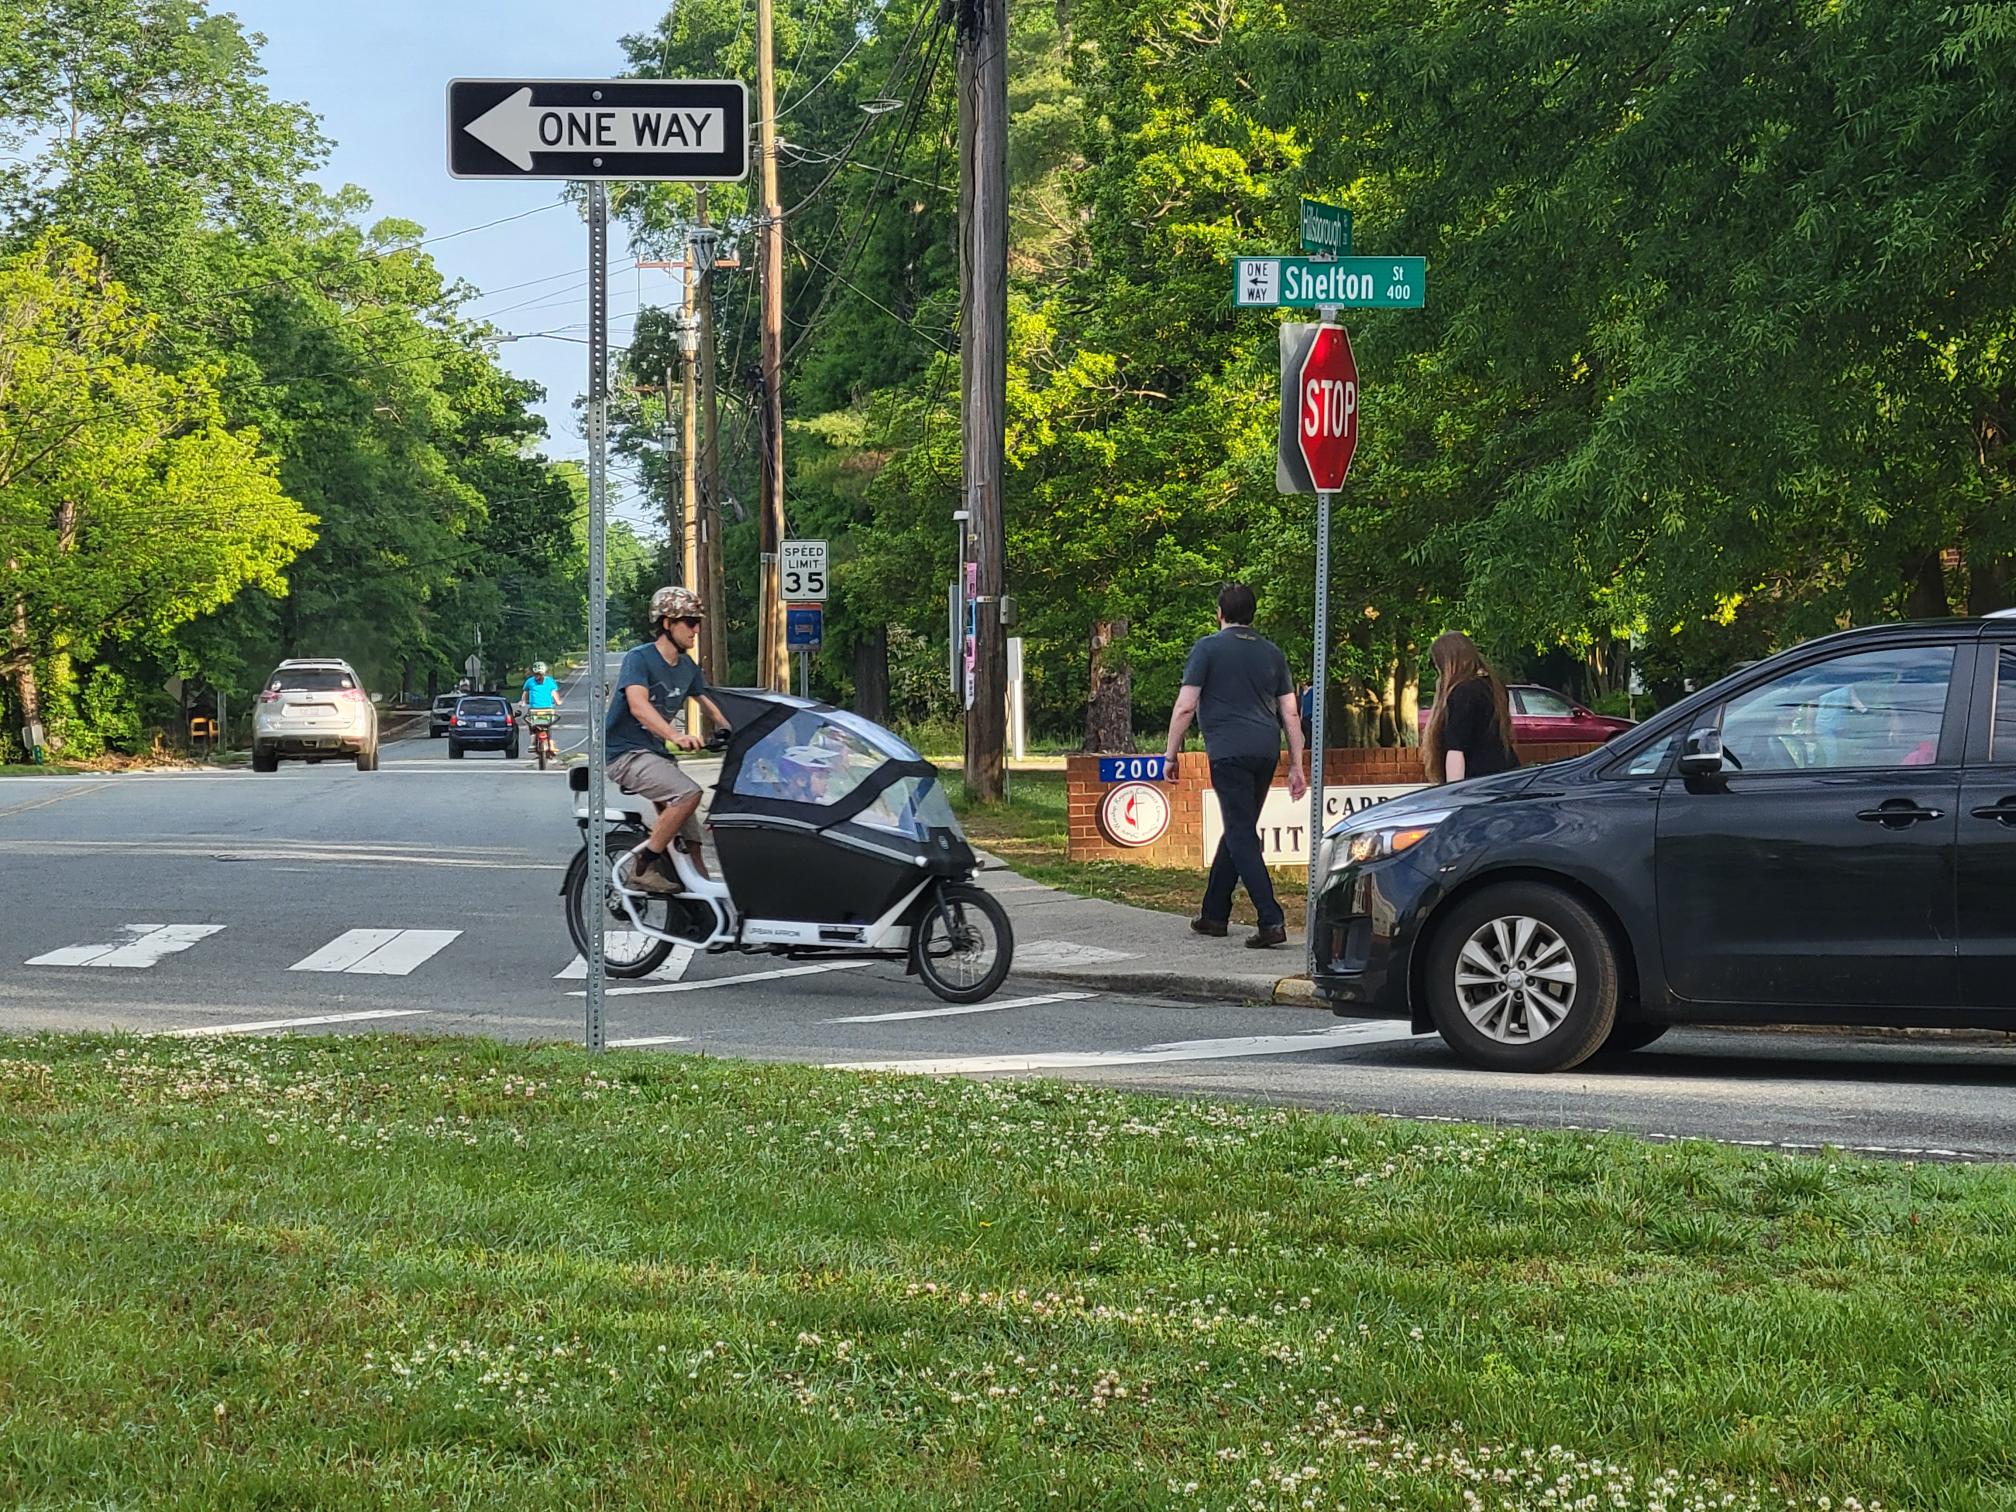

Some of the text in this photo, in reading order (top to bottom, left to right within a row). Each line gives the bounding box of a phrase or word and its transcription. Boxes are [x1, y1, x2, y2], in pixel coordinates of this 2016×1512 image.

[538, 112, 712, 147] ONE WAY
[1247, 262, 1269, 277] ONE
[1392, 265, 1404, 281] St
[1284, 265, 1374, 300] Shelton
[1246, 287, 1268, 302] WAY
[1386, 284, 1411, 300] 400
[1304, 377, 1356, 438] STOP
[784, 547, 824, 557] SPEED
[788, 559, 820, 569] LIMIT
[784, 571, 824, 593] 35
[1114, 759, 1158, 779] 200
